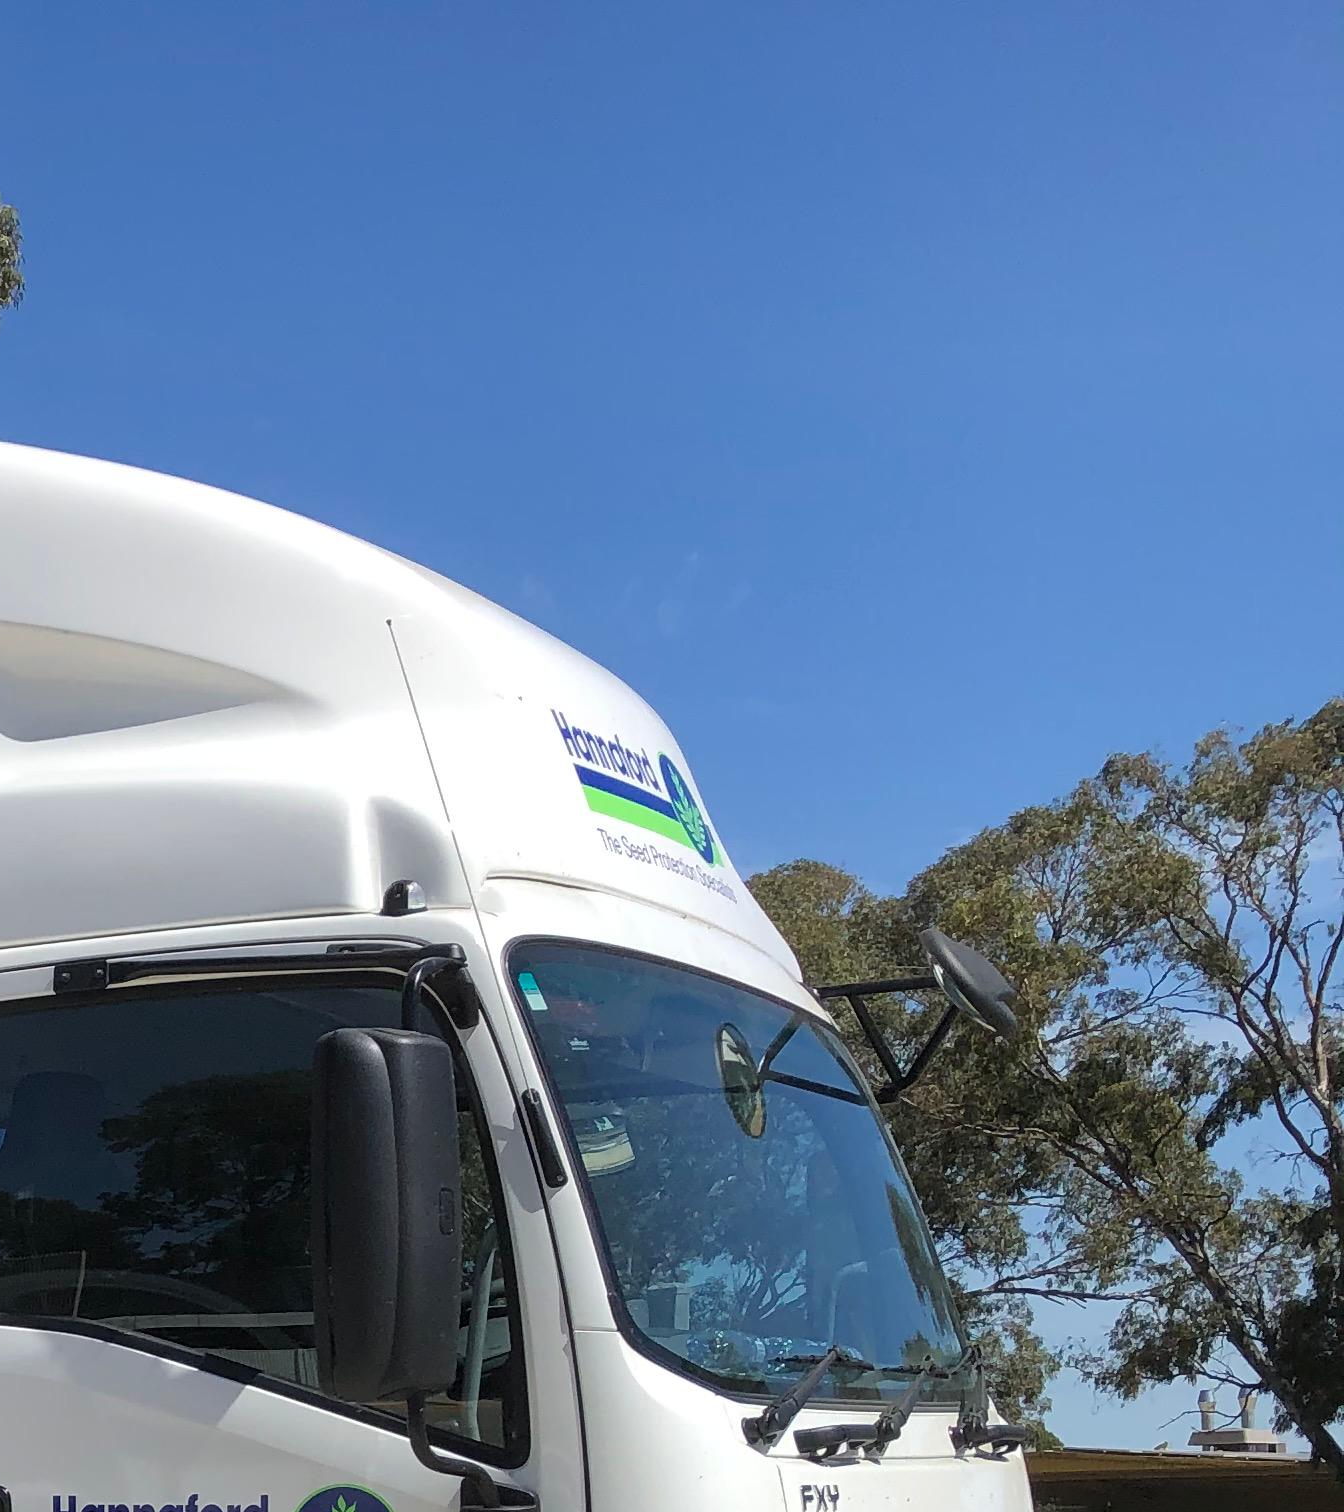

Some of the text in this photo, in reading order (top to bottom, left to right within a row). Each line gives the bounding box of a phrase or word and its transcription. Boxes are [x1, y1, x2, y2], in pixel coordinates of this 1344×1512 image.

[550, 708, 662, 793] Hannaford
[597, 827, 622, 855] The
[621, 836, 652, 864] Seed
[649, 845, 694, 880] Protection
[800, 1485, 839, 1512] FXY
